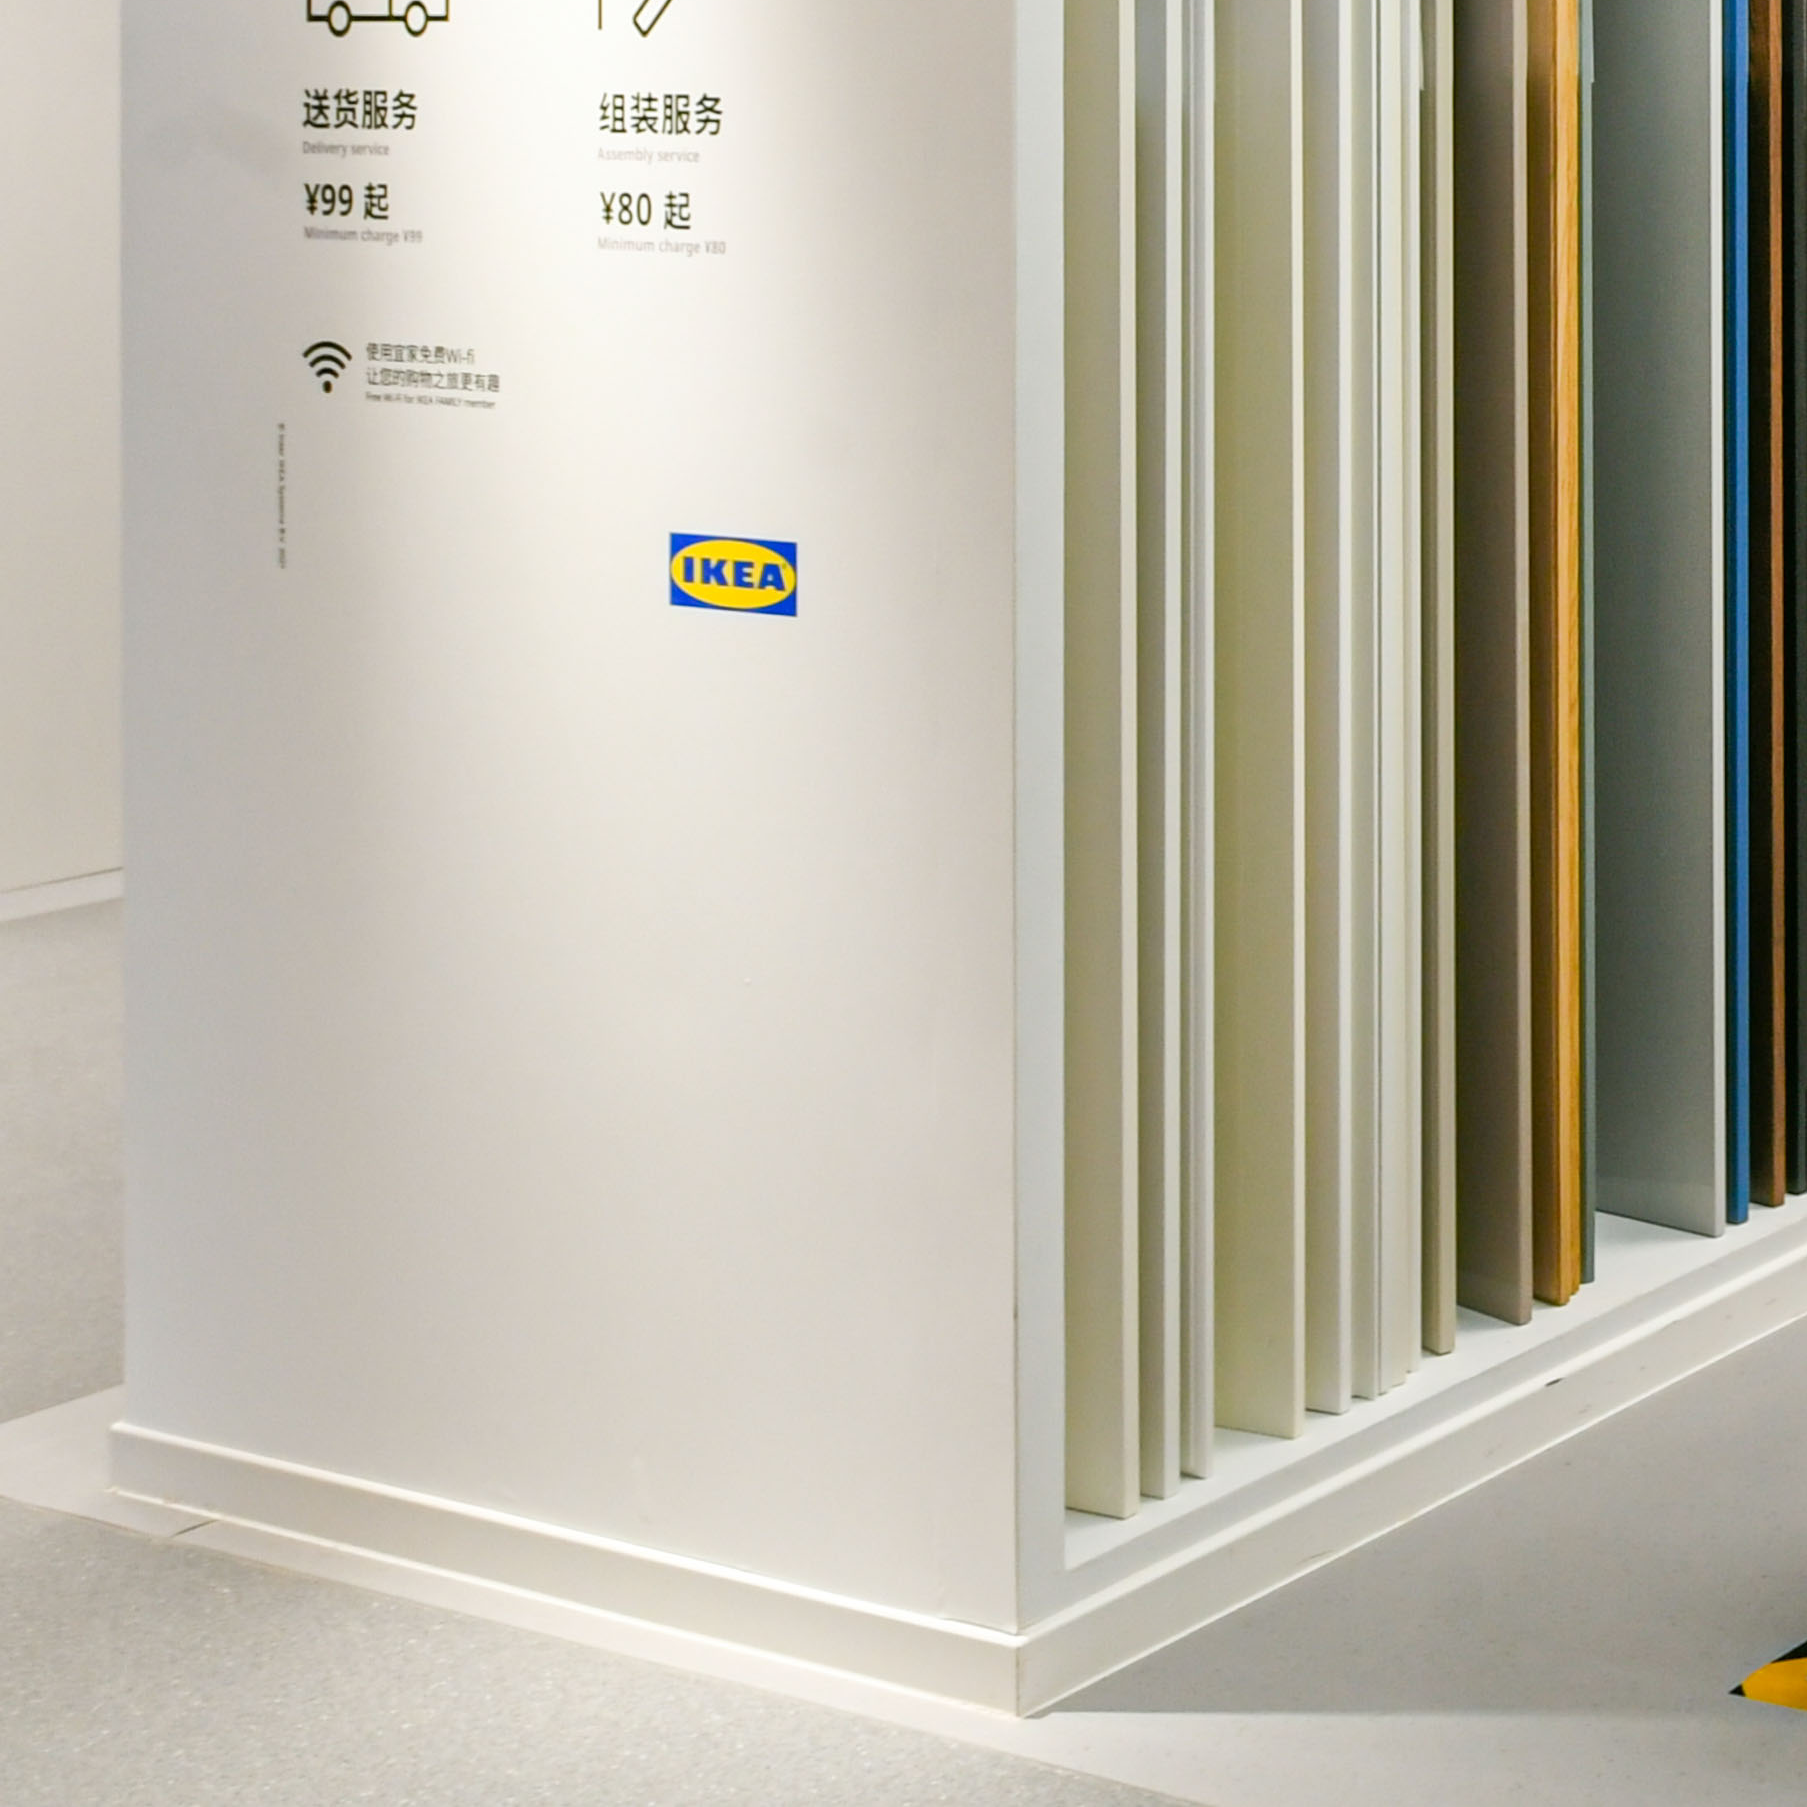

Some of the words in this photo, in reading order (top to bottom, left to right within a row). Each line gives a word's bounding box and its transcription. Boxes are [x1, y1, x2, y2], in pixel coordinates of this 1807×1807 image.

[302, 89, 418, 130] 送货服务
[599, 93, 723, 136] 组装服务
[302, 141, 348, 158] Delivery
[350, 143, 389, 156] service
[598, 146, 654, 164] Assembly
[657, 149, 700, 163] service
[304, 182, 354, 217] ¥99
[363, 183, 389, 220] 起
[600, 191, 652, 226] ¥80
[663, 191, 691, 231] 起
[304, 226, 358, 242] Minimum
[360, 228, 399, 245] charge
[598, 237, 655, 253] Minimum
[658, 239, 701, 257] charge
[683, 556, 786, 591] IKEA
